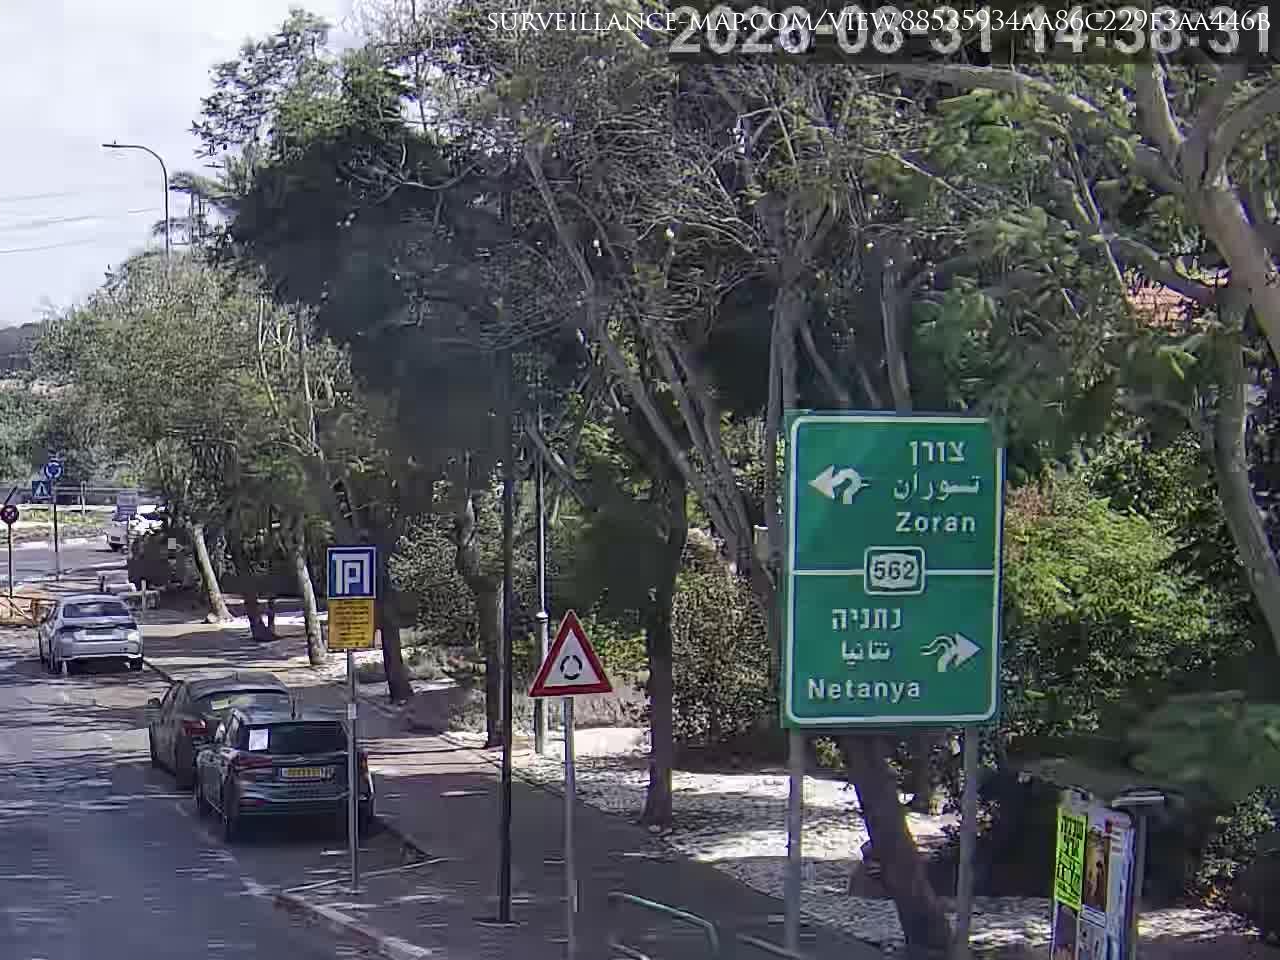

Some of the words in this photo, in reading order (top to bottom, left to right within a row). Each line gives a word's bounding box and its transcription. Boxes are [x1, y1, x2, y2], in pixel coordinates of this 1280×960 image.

[909, 441, 965, 466] צורן
[896, 512, 976, 533] Zoran
[874, 560, 915, 580] 562
[832, 608, 901, 629] נתניה
[808, 679, 920, 703] Netanya
